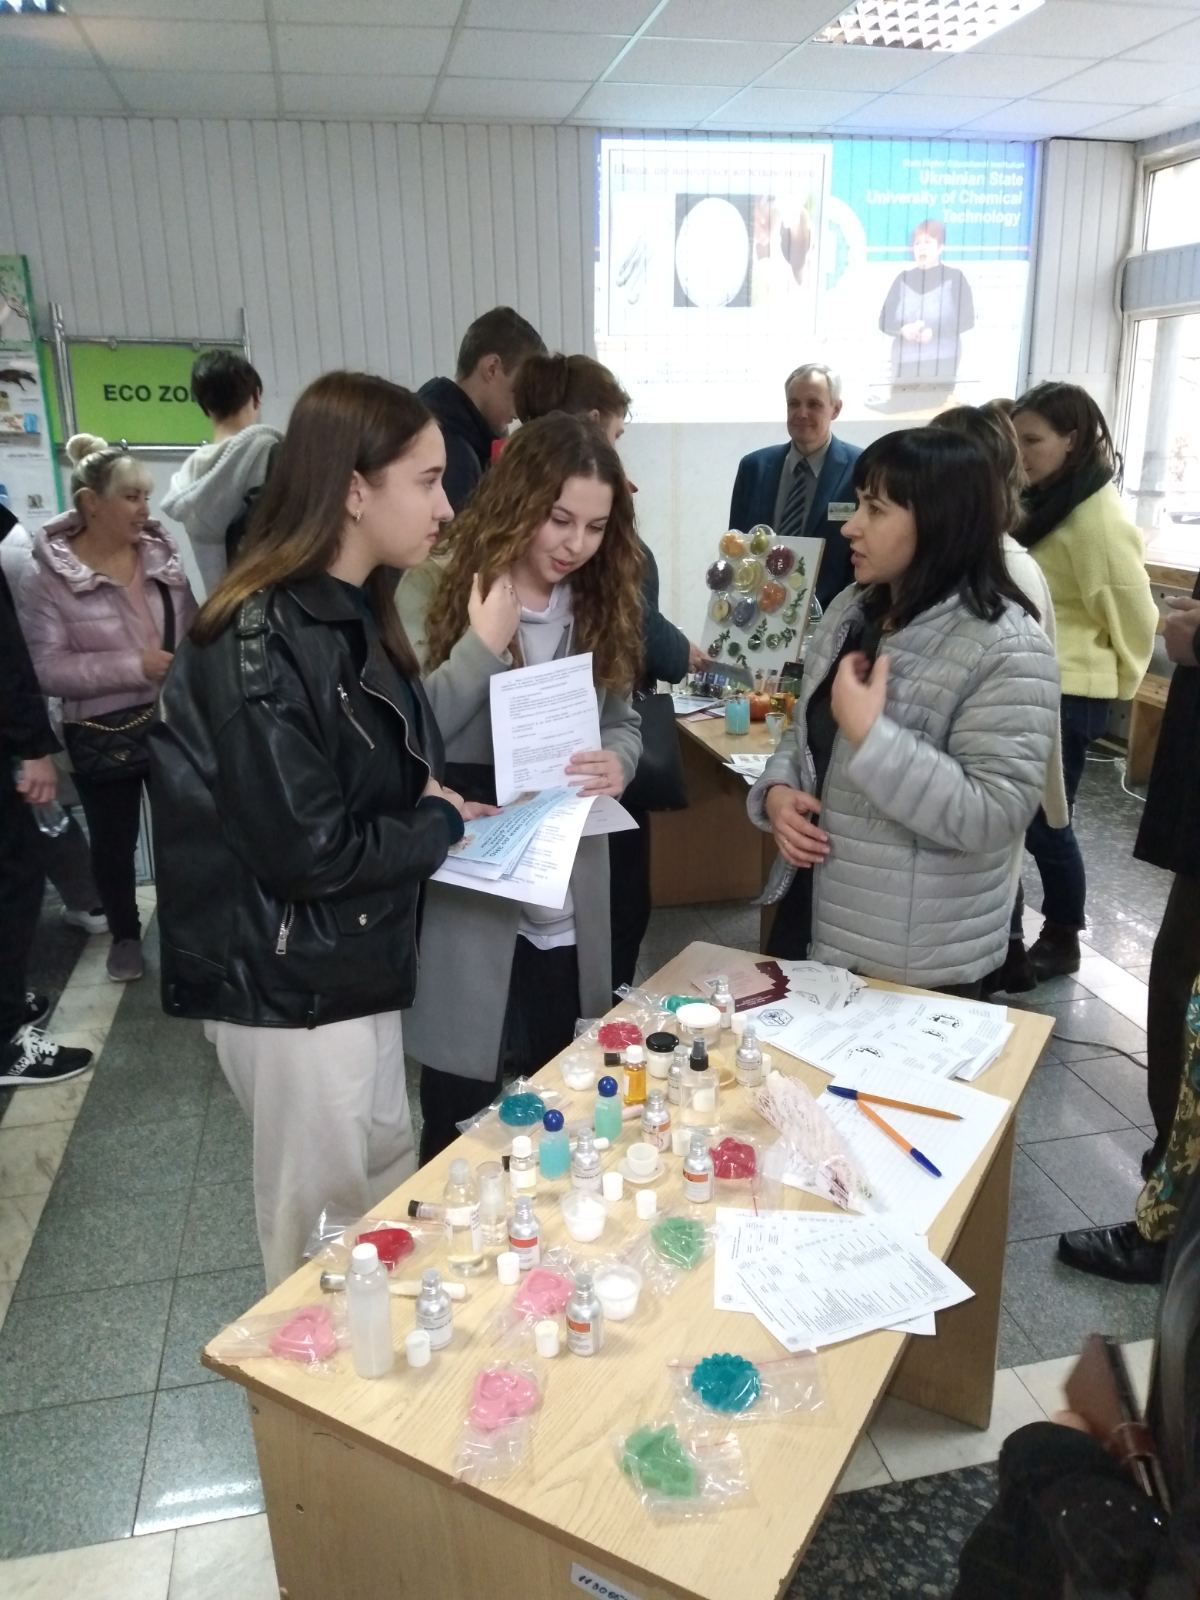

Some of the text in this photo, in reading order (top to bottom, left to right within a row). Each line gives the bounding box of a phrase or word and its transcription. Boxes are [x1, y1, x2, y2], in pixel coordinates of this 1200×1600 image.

[920, 171, 1024, 186] Ukrainian State
[866, 190, 1023, 206] University of Chemical
[944, 209, 1021, 227] Technology
[104, 384, 151, 402] ECO
